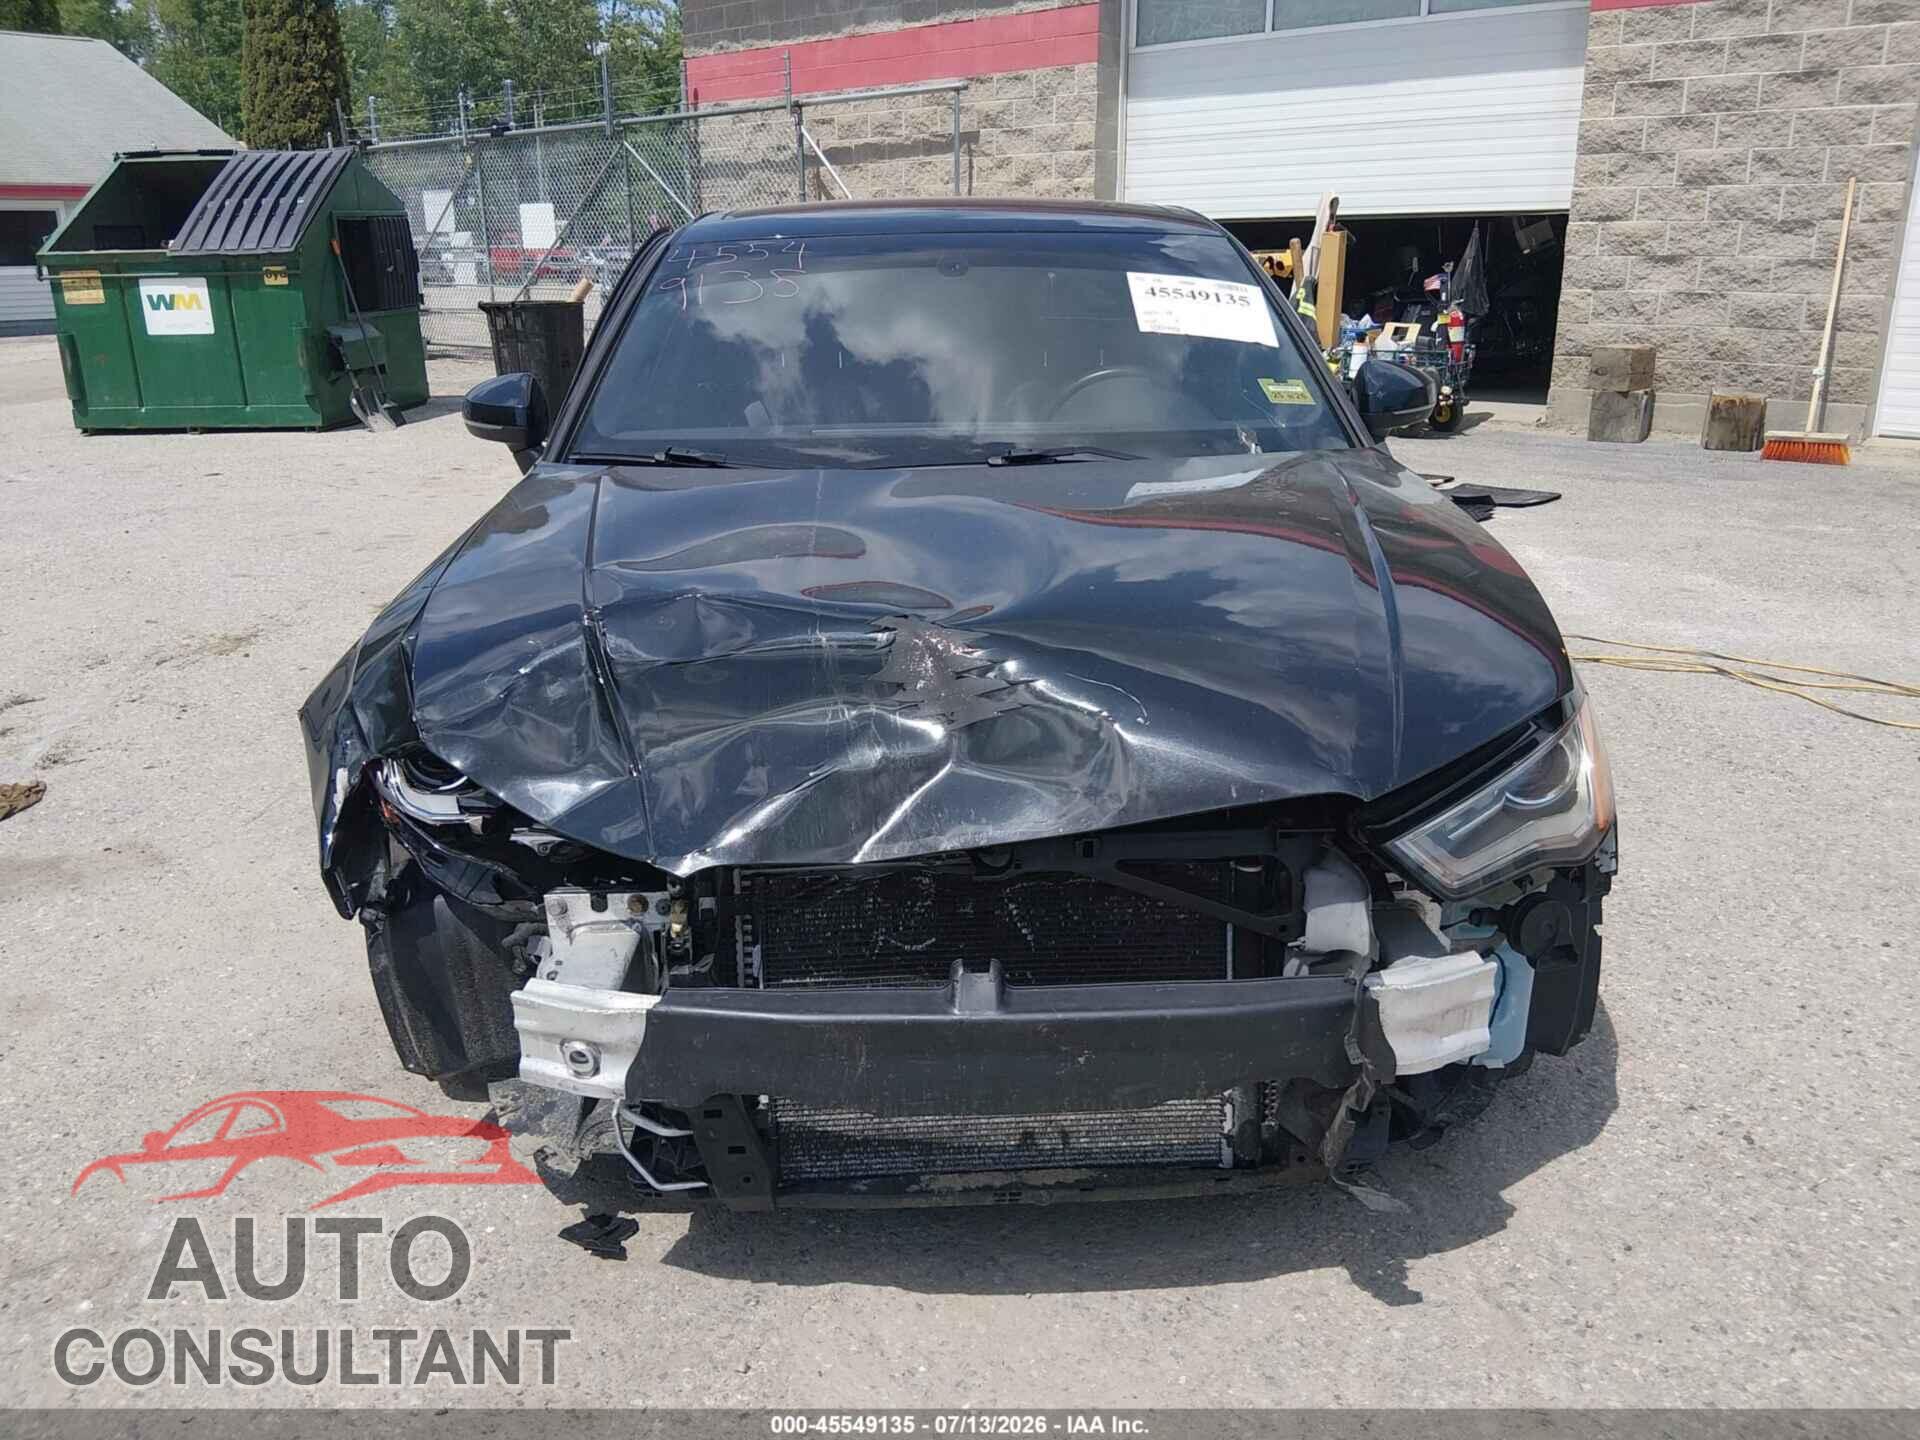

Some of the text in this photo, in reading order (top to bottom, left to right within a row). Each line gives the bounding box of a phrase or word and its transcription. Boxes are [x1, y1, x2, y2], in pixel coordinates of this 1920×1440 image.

[667, 241, 812, 269] 4554
[146, 293, 203, 311] WM
[659, 269, 807, 311] 9135
[1144, 286, 1251, 307] 45549135
